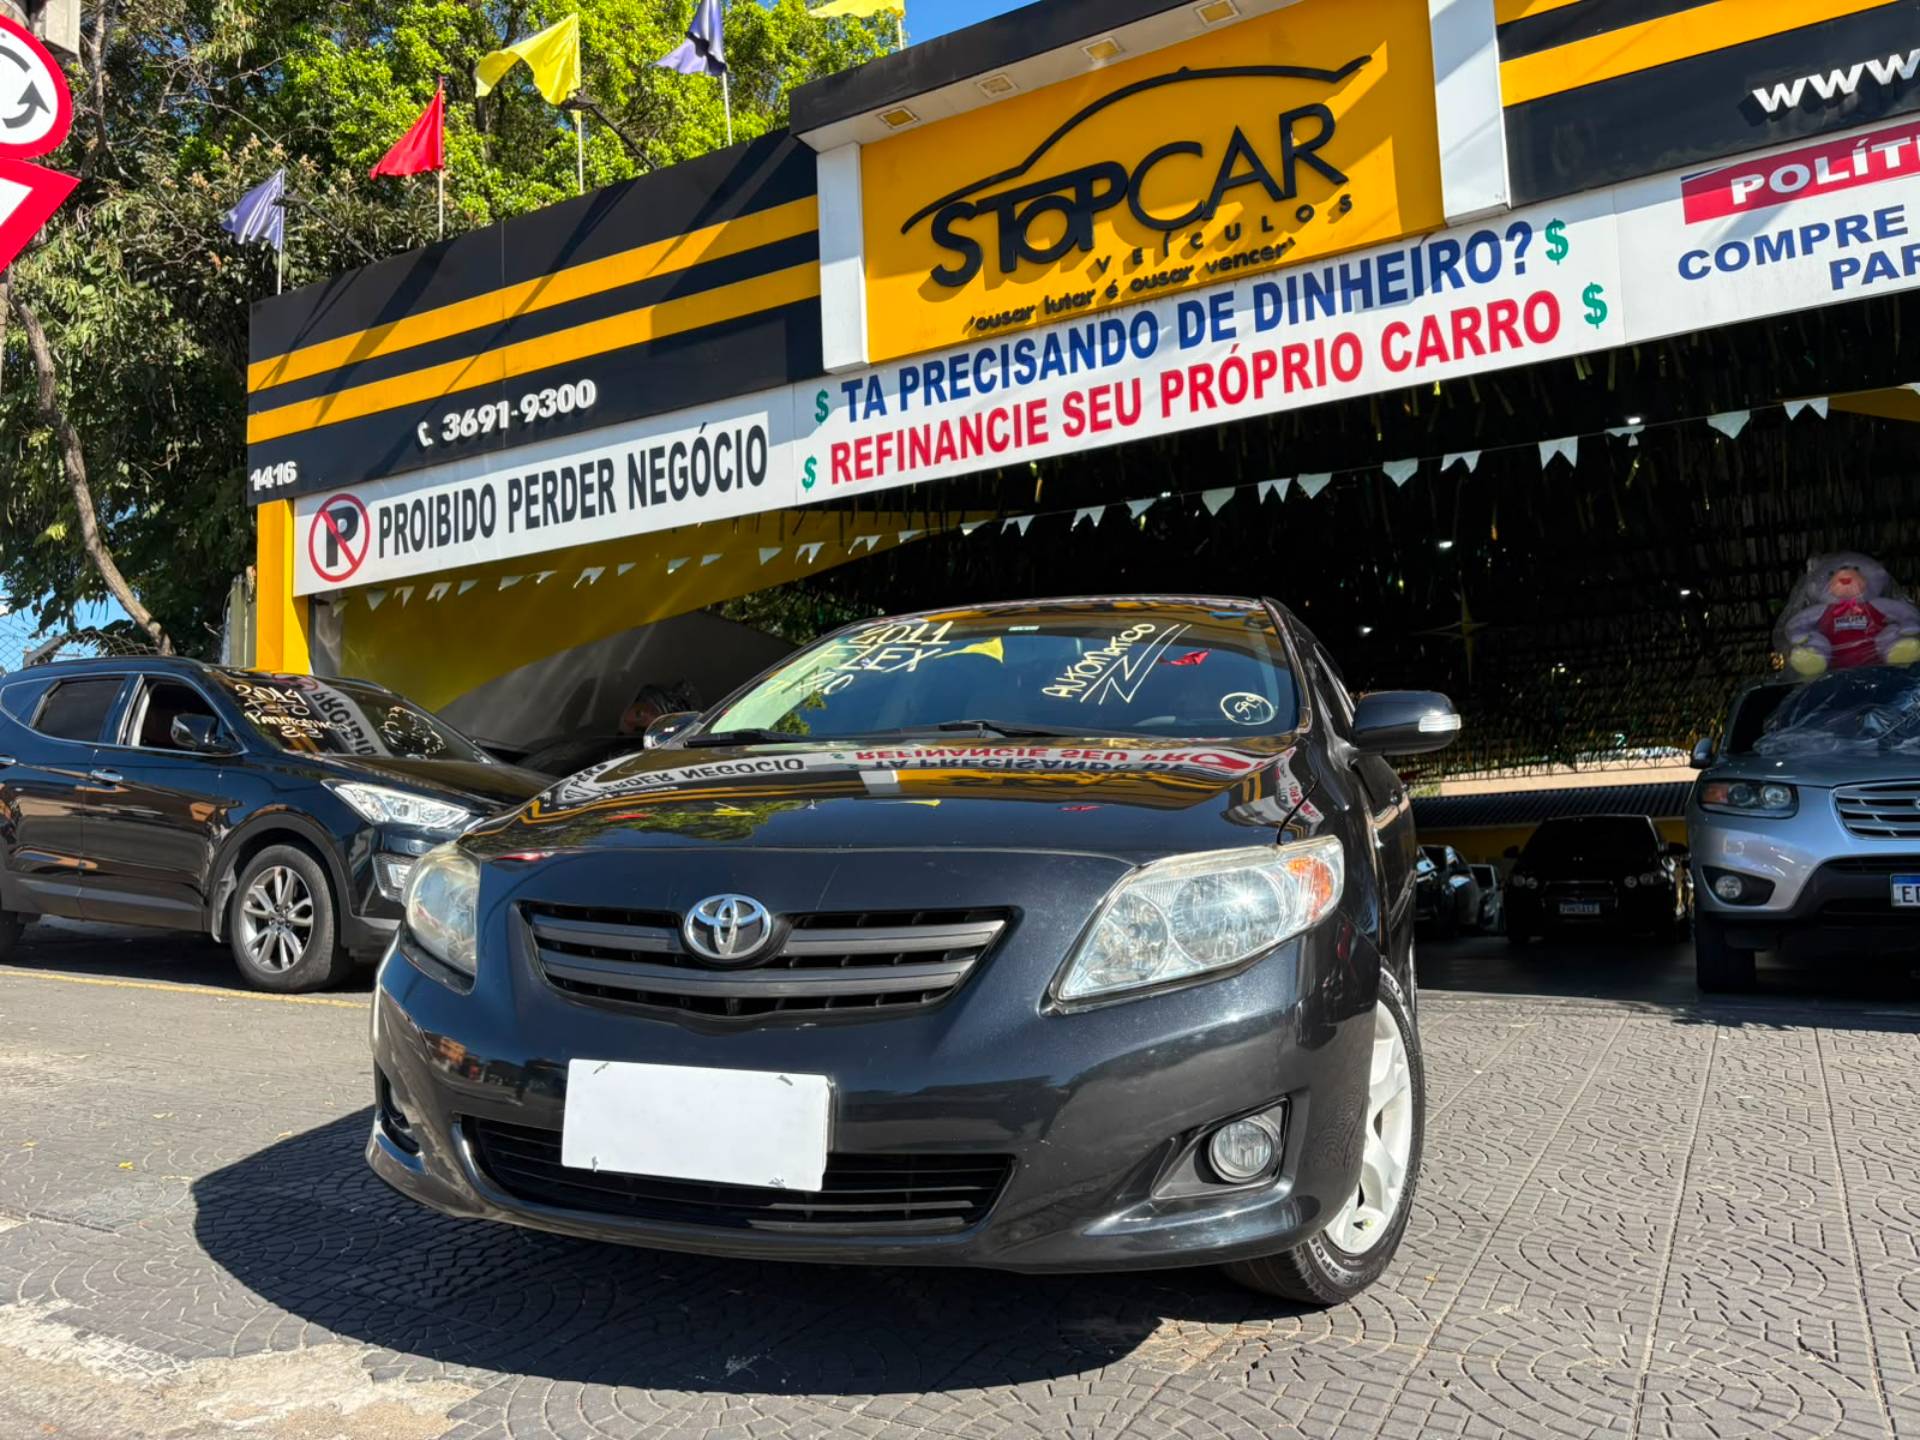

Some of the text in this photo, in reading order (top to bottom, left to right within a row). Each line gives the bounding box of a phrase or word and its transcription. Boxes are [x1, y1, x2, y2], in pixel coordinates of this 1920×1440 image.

[1730, 136, 1920, 206] POLÍT
[1095, 193, 1355, 274] VEÍCULOS
[1678, 203, 1909, 282] COMPRE
[841, 373, 888, 424] TA
[899, 309, 1160, 412] PRECISANDO
[1177, 289, 1238, 351] DE
[1253, 219, 1534, 332] DINHEIRO?
[1043, 286, 1096, 316] lutar
[1105, 278, 1120, 300] é
[1130, 264, 1195, 293] ousar
[441, 378, 597, 443] 3691-9300
[831, 397, 1050, 486] REFINANCIE
[1062, 377, 1142, 438] SEU
[1160, 320, 1364, 419] PRÓPRIO
[1379, 289, 1562, 374] CARRO
[250, 460, 297, 492] 1416
[379, 422, 768, 560] PROIBIDO PERDER NEGÓCIO
